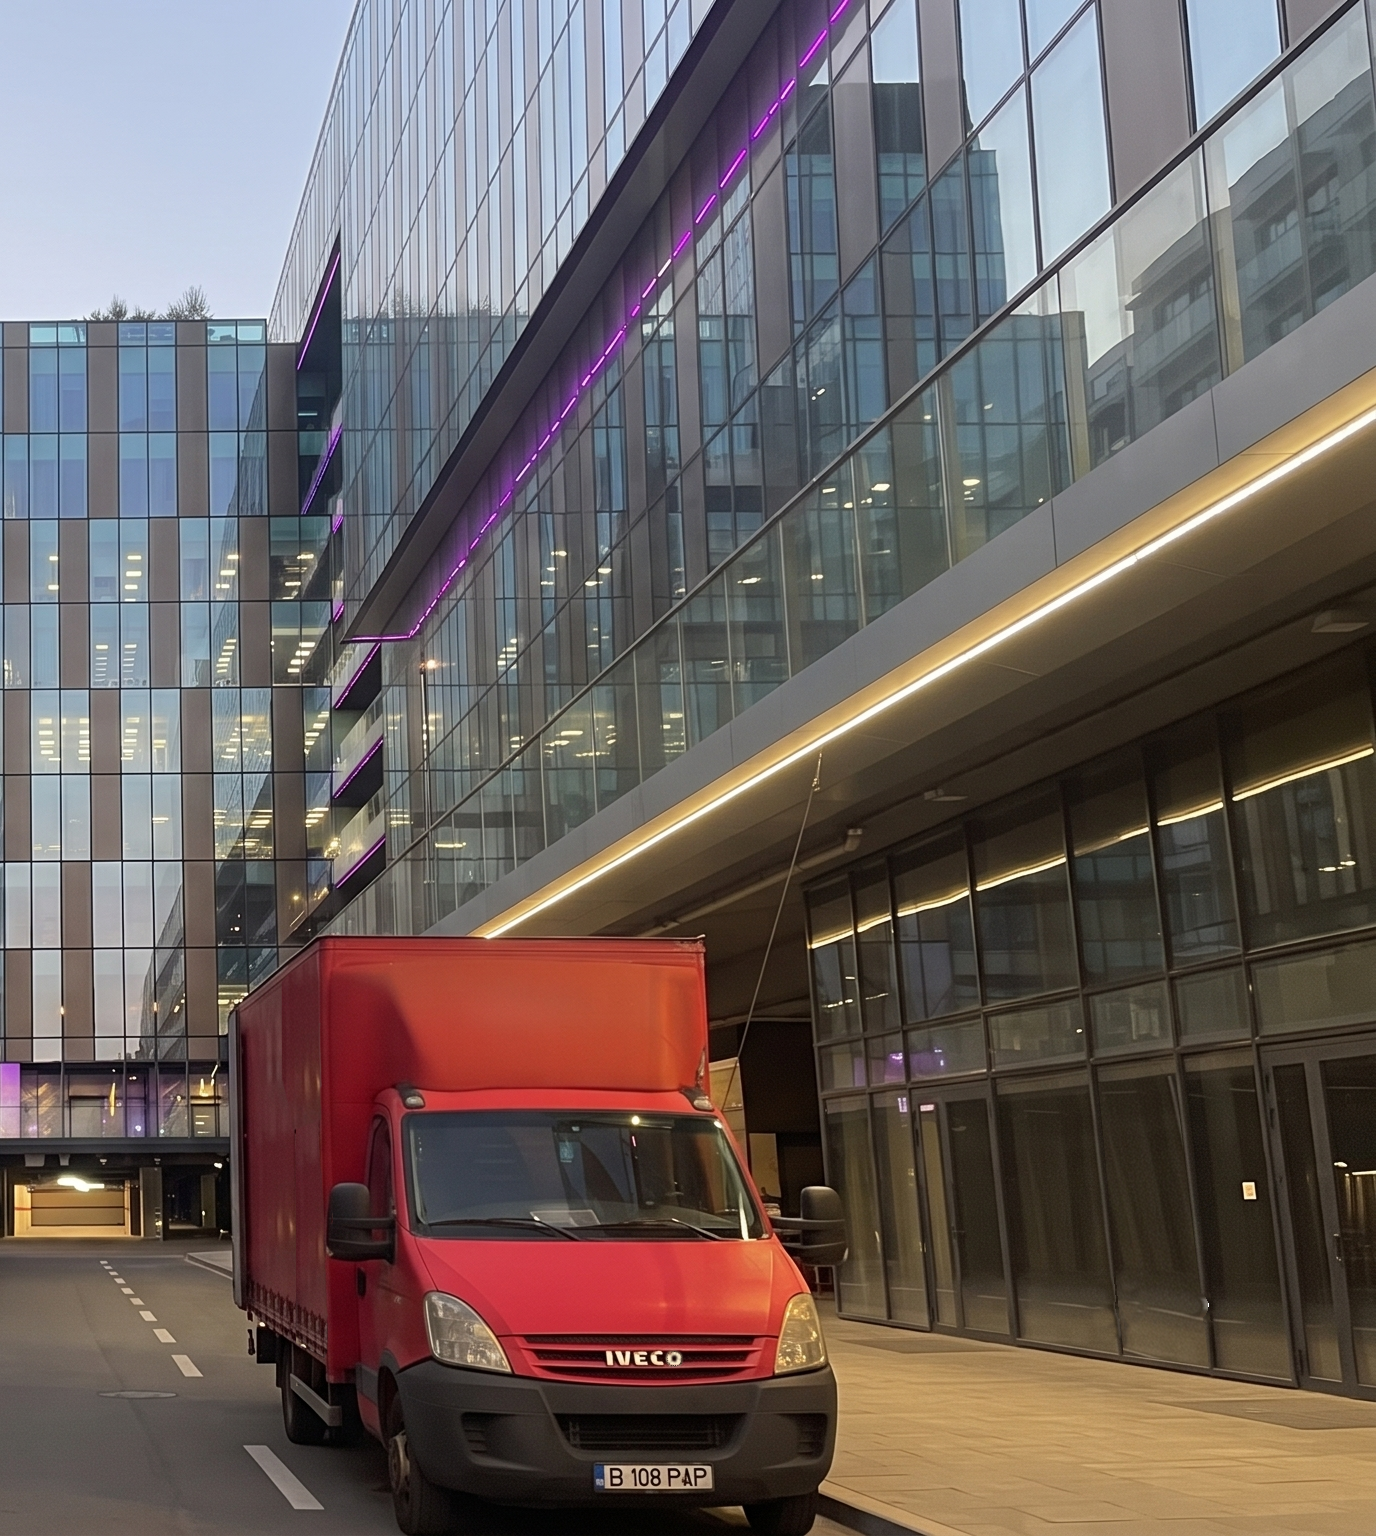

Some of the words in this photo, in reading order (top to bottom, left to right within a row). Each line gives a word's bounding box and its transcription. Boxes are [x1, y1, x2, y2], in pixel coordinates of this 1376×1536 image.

[605, 1350, 683, 1367] IVECO
[609, 1467, 624, 1487] B
[631, 1467, 662, 1487] 108
[667, 1467, 707, 1487] PAP
